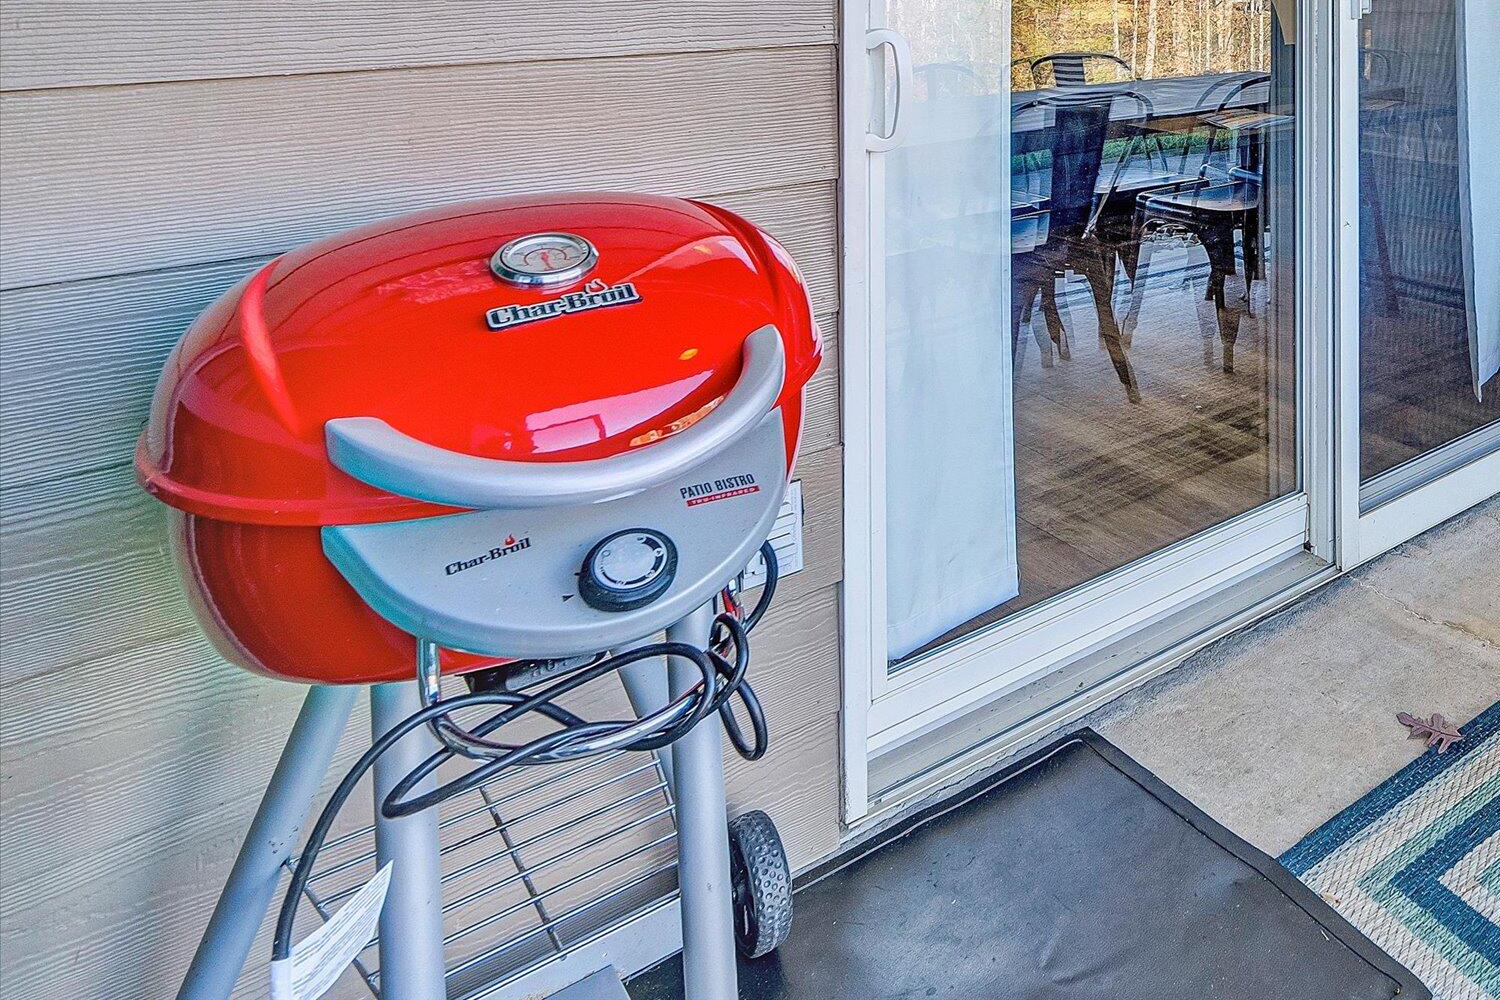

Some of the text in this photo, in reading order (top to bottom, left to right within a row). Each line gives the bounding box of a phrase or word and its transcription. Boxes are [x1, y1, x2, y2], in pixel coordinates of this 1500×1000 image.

[490, 283, 636, 326] Char-Broil
[680, 473, 755, 499] PATIO BISTRO
[445, 537, 532, 576] Char-Broil
